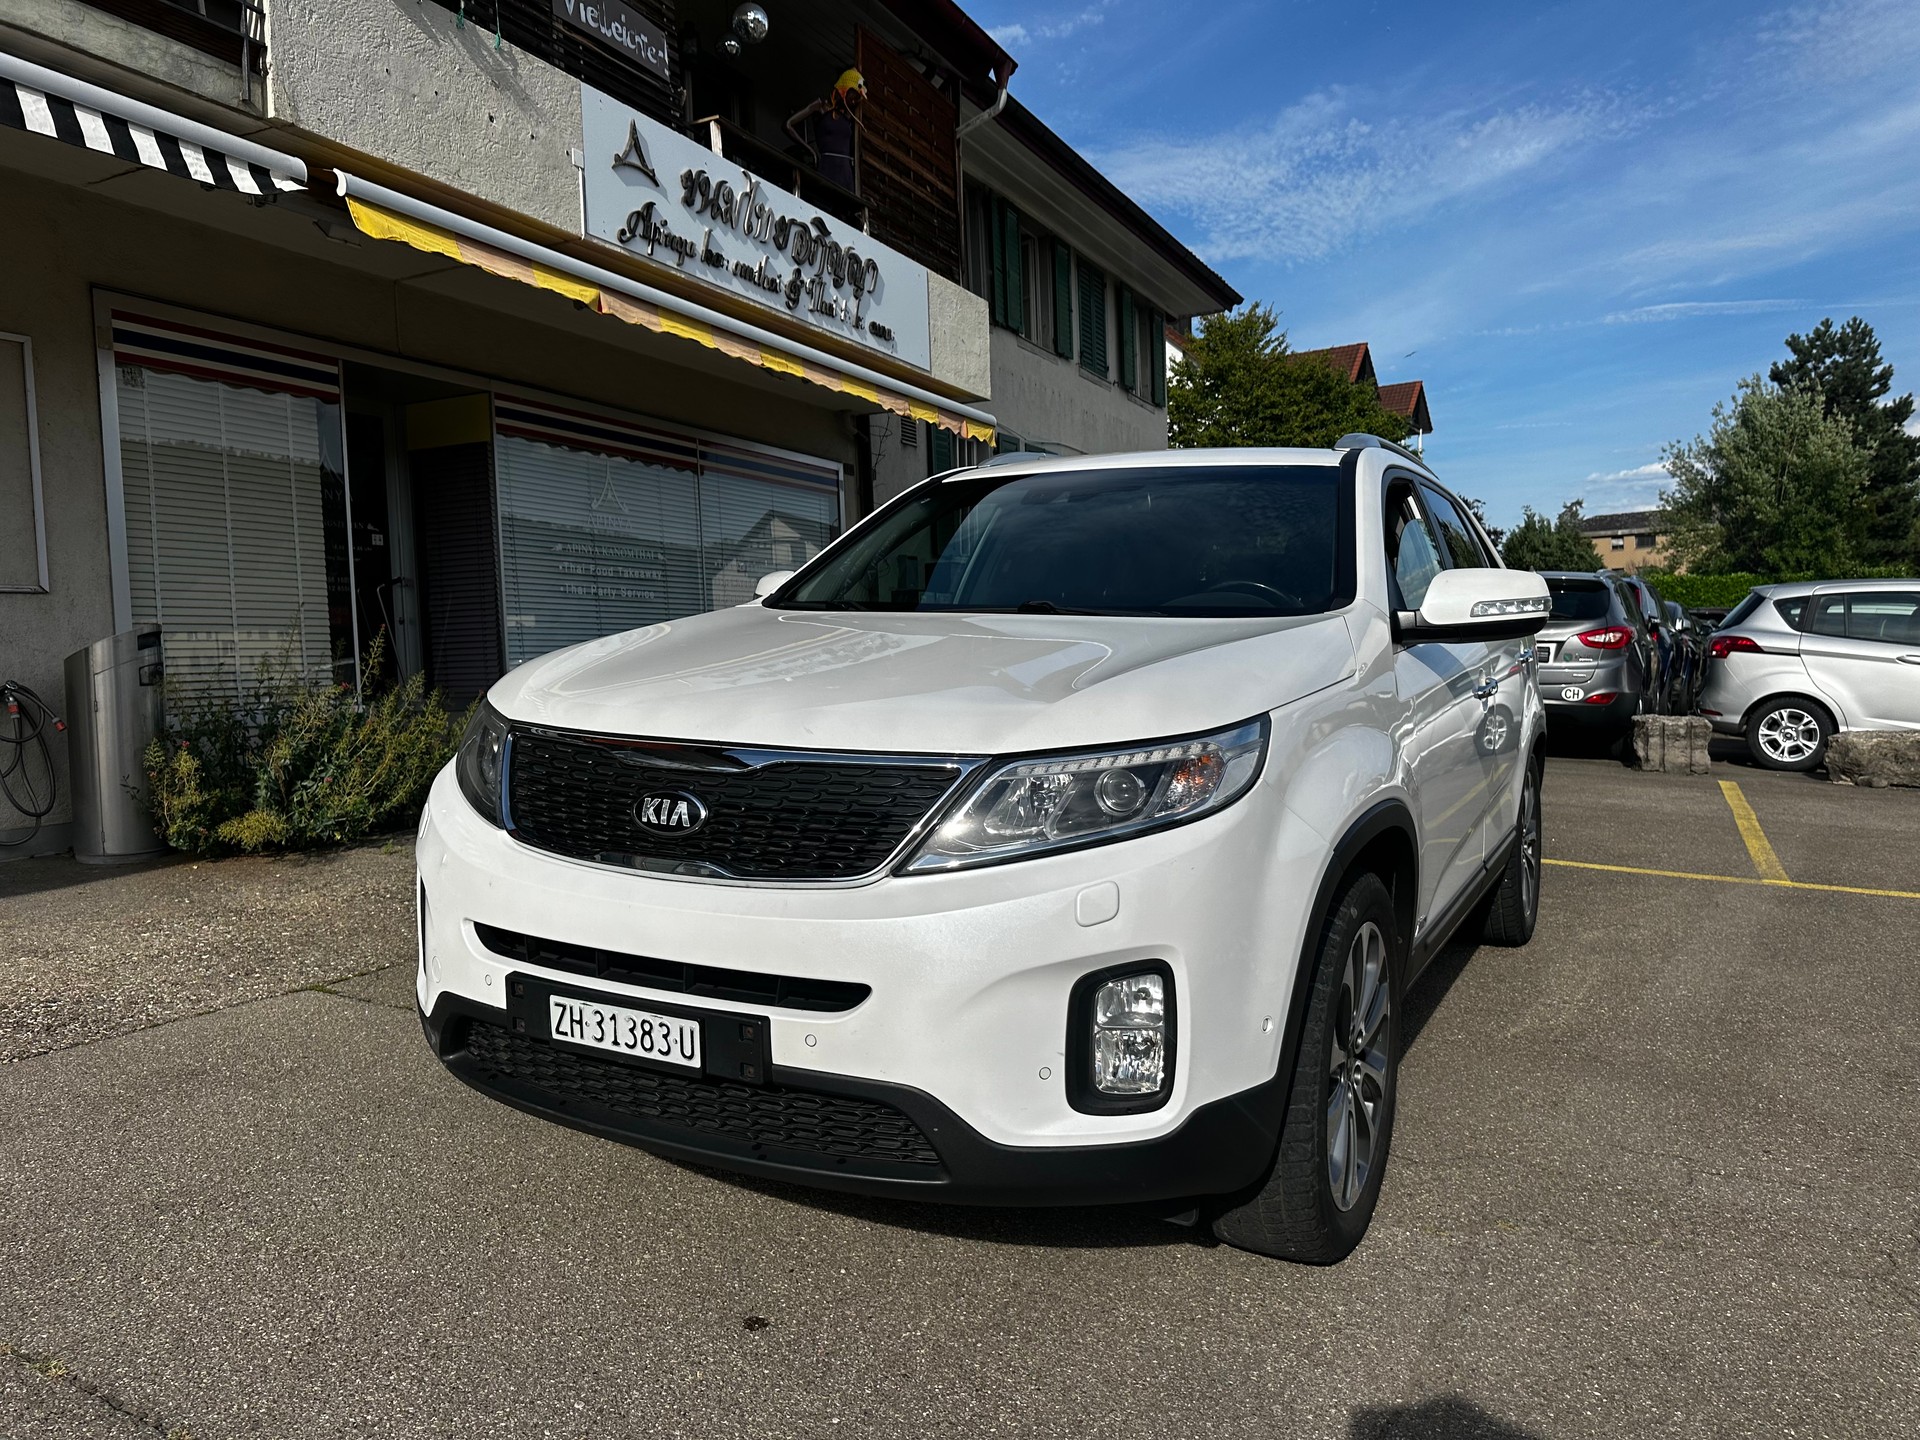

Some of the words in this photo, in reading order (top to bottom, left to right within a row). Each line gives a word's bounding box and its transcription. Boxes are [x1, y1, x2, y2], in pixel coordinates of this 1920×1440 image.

[617, 201, 697, 266] Apinya
[785, 268, 804, 309] &
[590, 565, 614, 576] Food
[618, 567, 662, 580] Takeaway
[591, 585, 616, 599] Party
[620, 587, 655, 599] Service
[1564, 688, 1580, 699] CH
[641, 797, 690, 827] KIA
